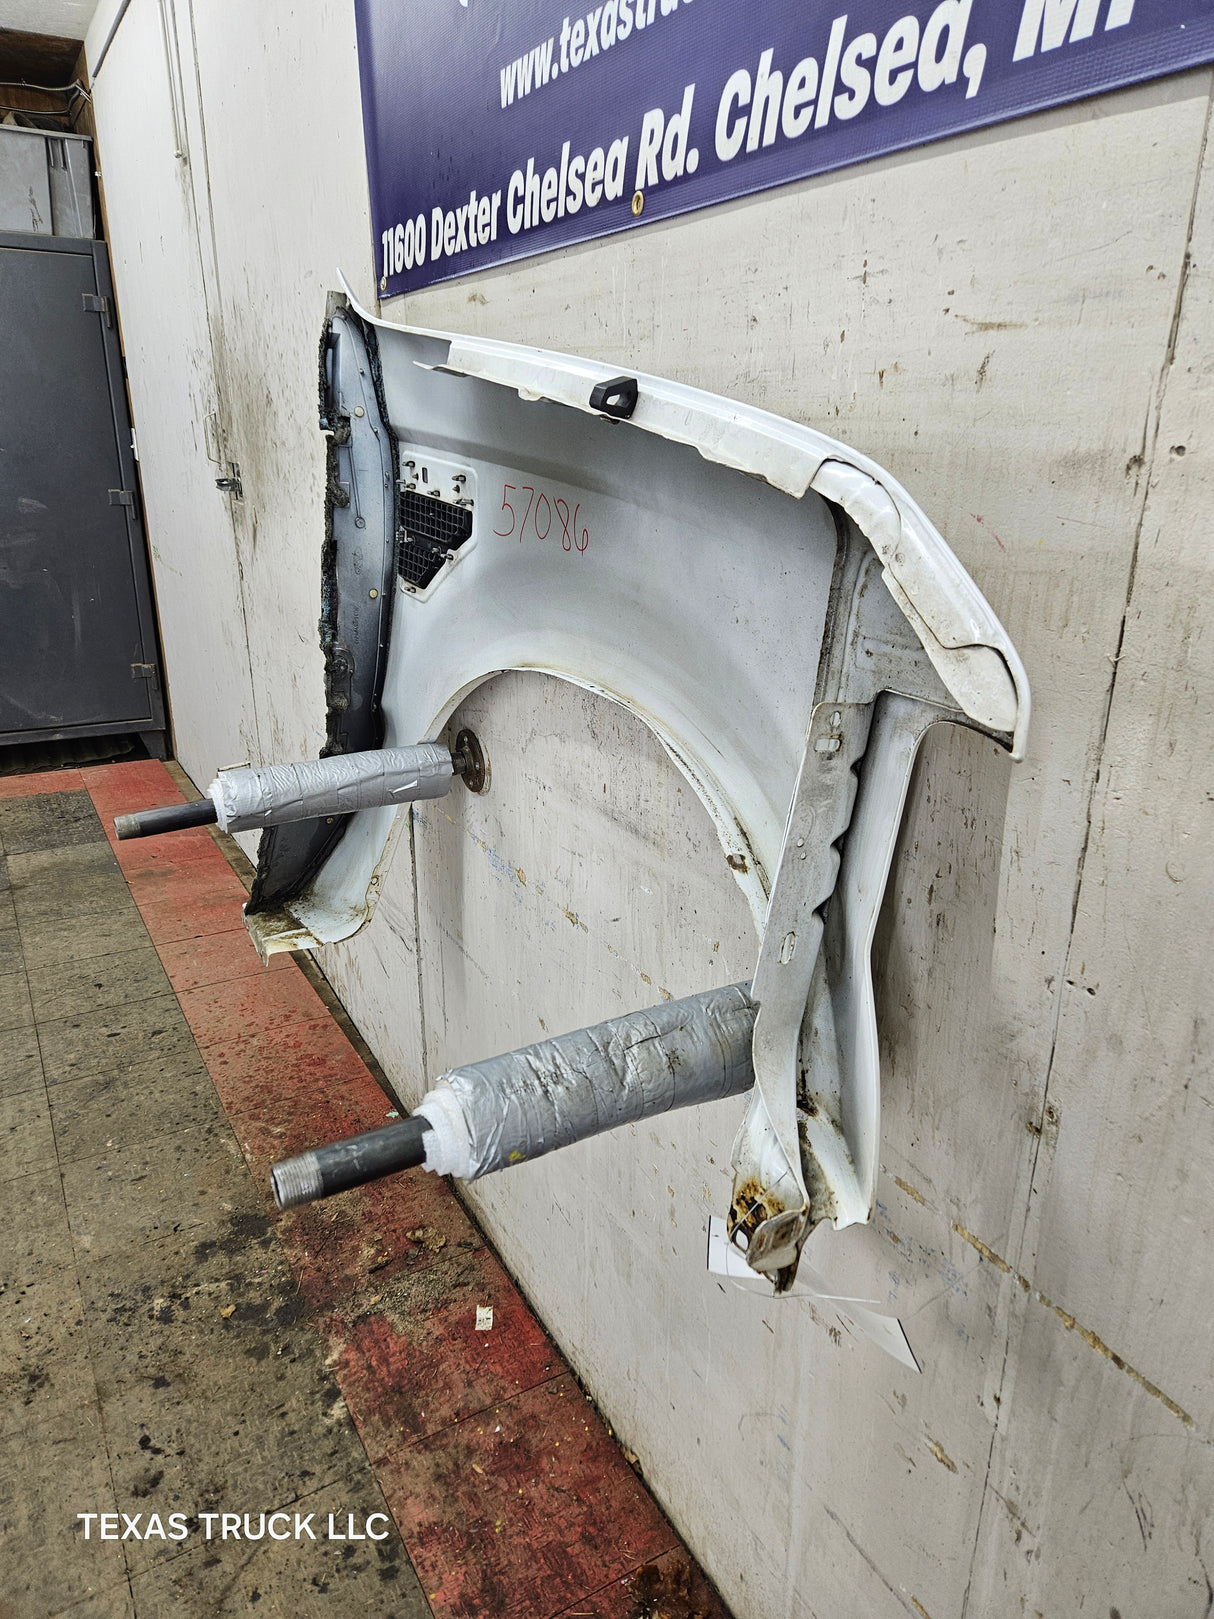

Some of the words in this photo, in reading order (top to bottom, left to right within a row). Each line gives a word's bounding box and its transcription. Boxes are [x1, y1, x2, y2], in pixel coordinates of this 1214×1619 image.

[381, 213, 427, 278] 11600
[430, 190, 502, 261] Dexter
[506, 136, 629, 234] Chelsea
[634, 83, 699, 191] Rd.
[714, 0, 987, 162] Chelsea,
[492, 484, 589, 557] 57086
